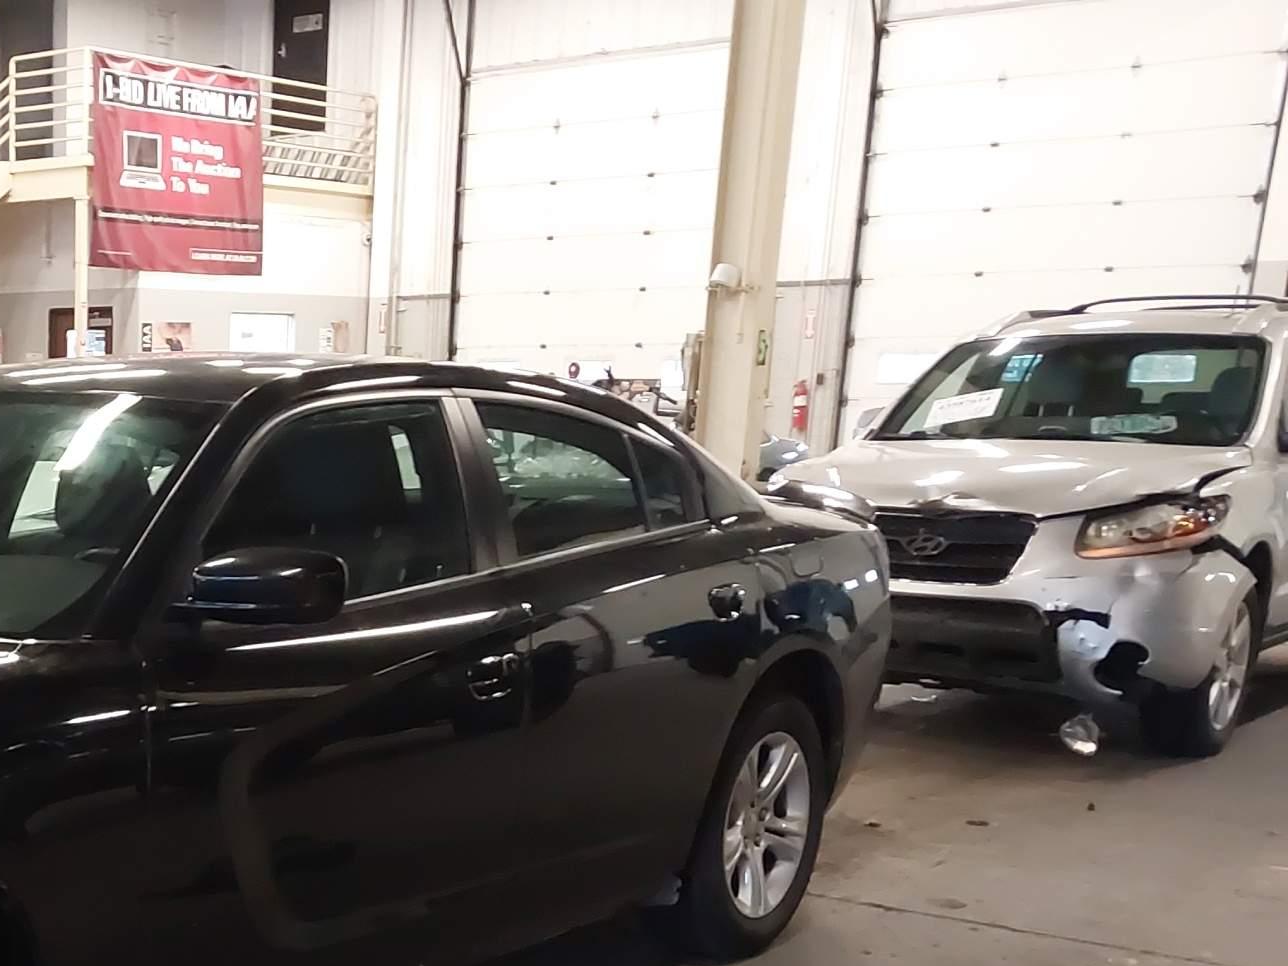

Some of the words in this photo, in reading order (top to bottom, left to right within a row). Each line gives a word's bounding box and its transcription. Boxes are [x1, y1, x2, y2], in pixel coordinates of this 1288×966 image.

[147, 82, 182, 112] LIVE
[182, 88, 226, 117] FROM
[171, 157, 193, 173] The
[195, 160, 242, 178] Auction
[170, 176, 185, 193] To
[187, 178, 210, 195] You
